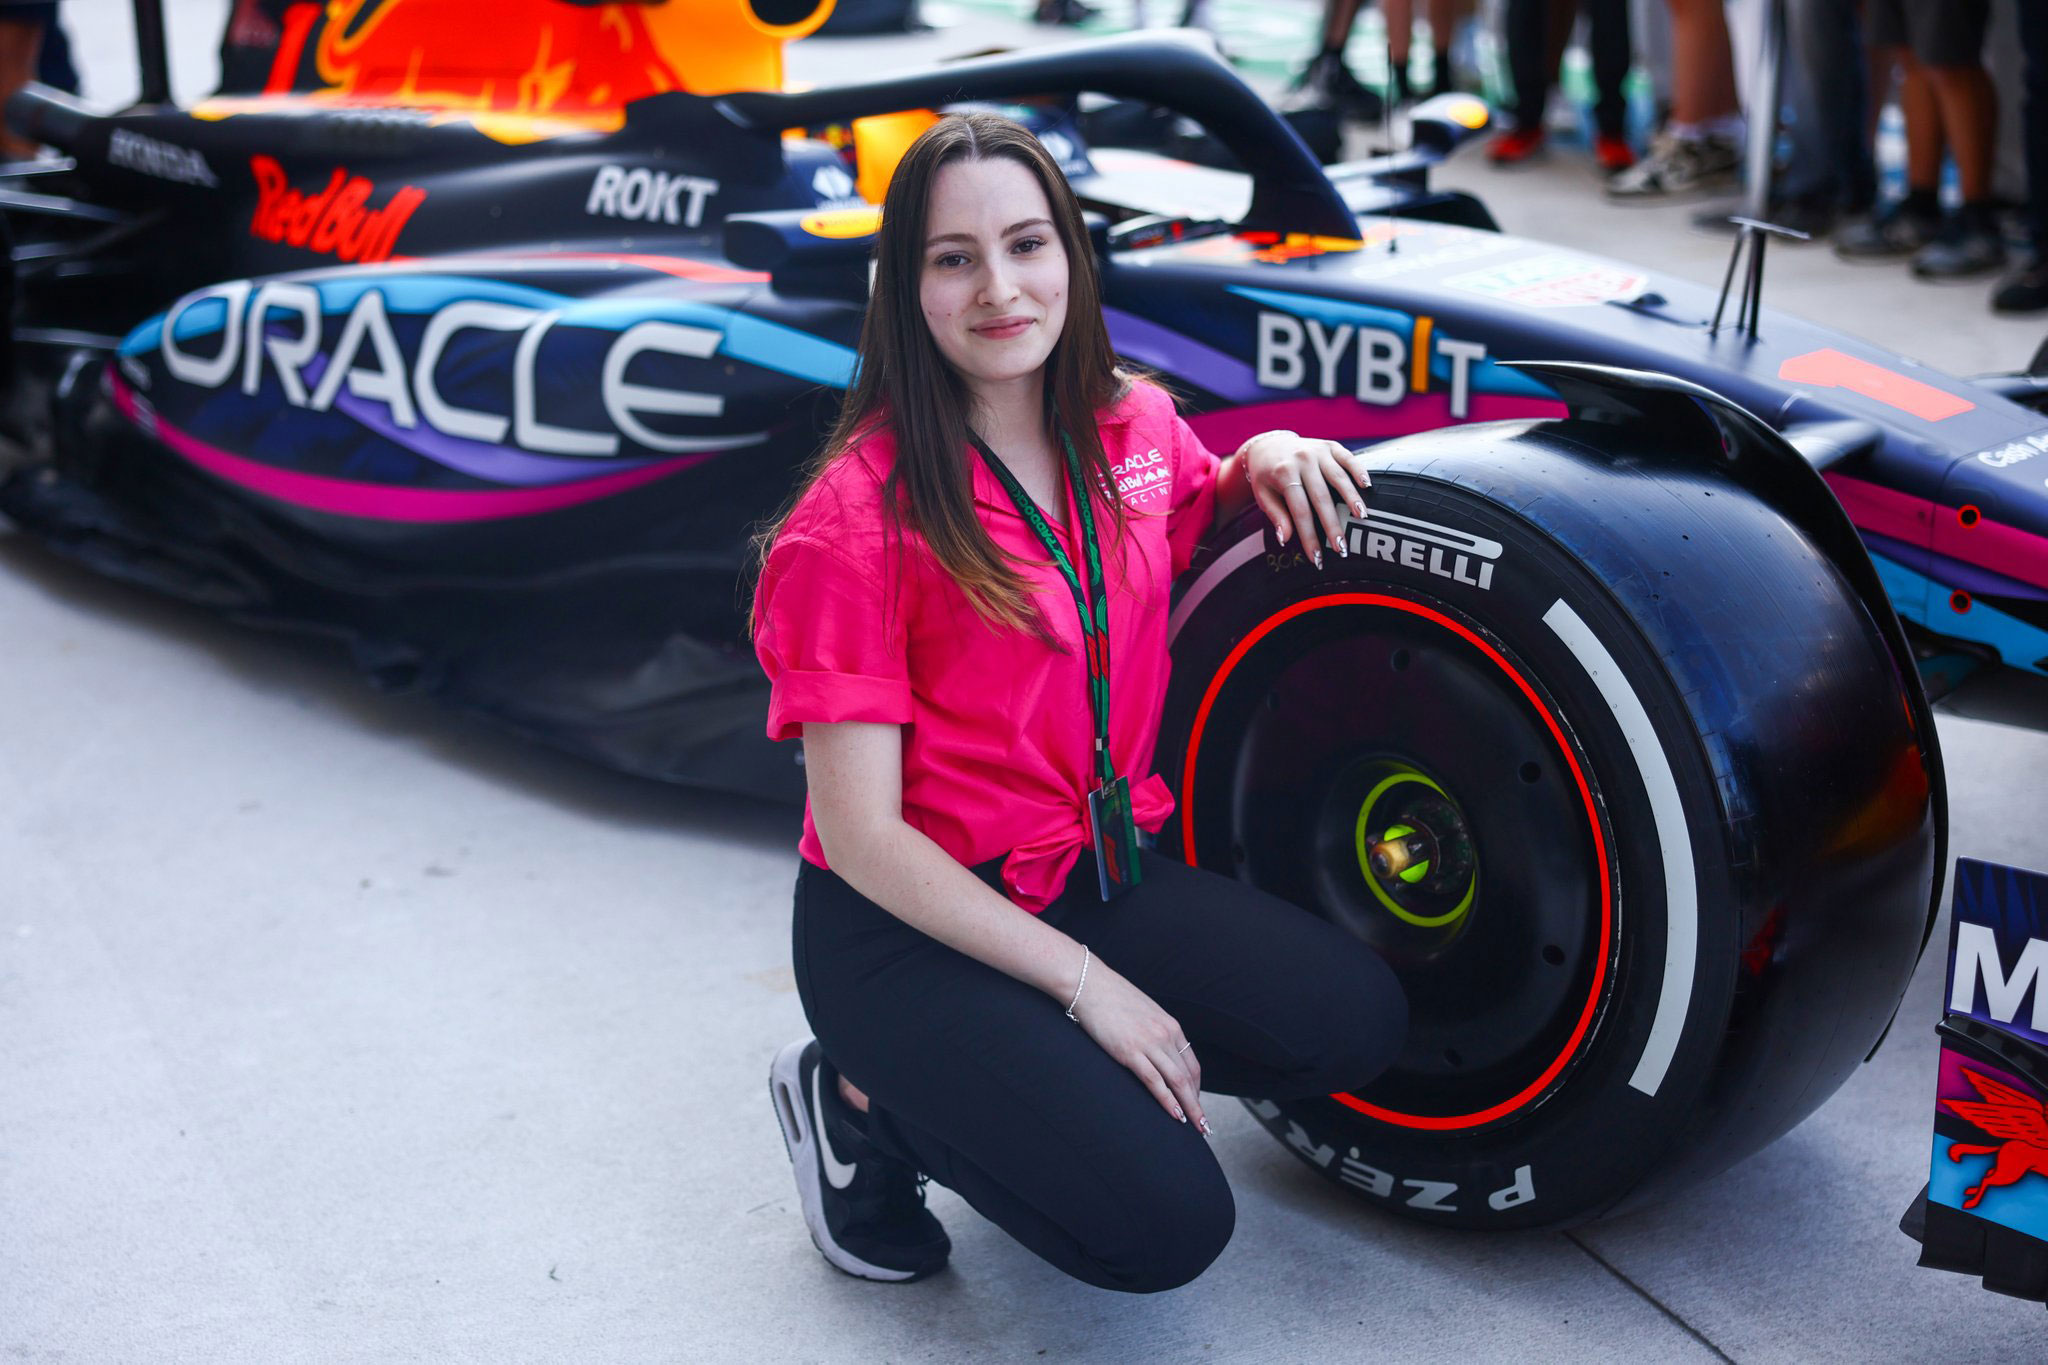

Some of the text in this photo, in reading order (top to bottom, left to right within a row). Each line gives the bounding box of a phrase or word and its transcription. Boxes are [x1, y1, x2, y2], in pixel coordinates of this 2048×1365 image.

[585, 164, 720, 228] ROKT
[161, 279, 770, 457] ORACLE
[1257, 311, 1488, 419] BYBIT
[1099, 448, 1163, 479] RACLE
[1014, 488, 1057, 548] PADDOCK
[1488, 1165, 1536, 1211] P
